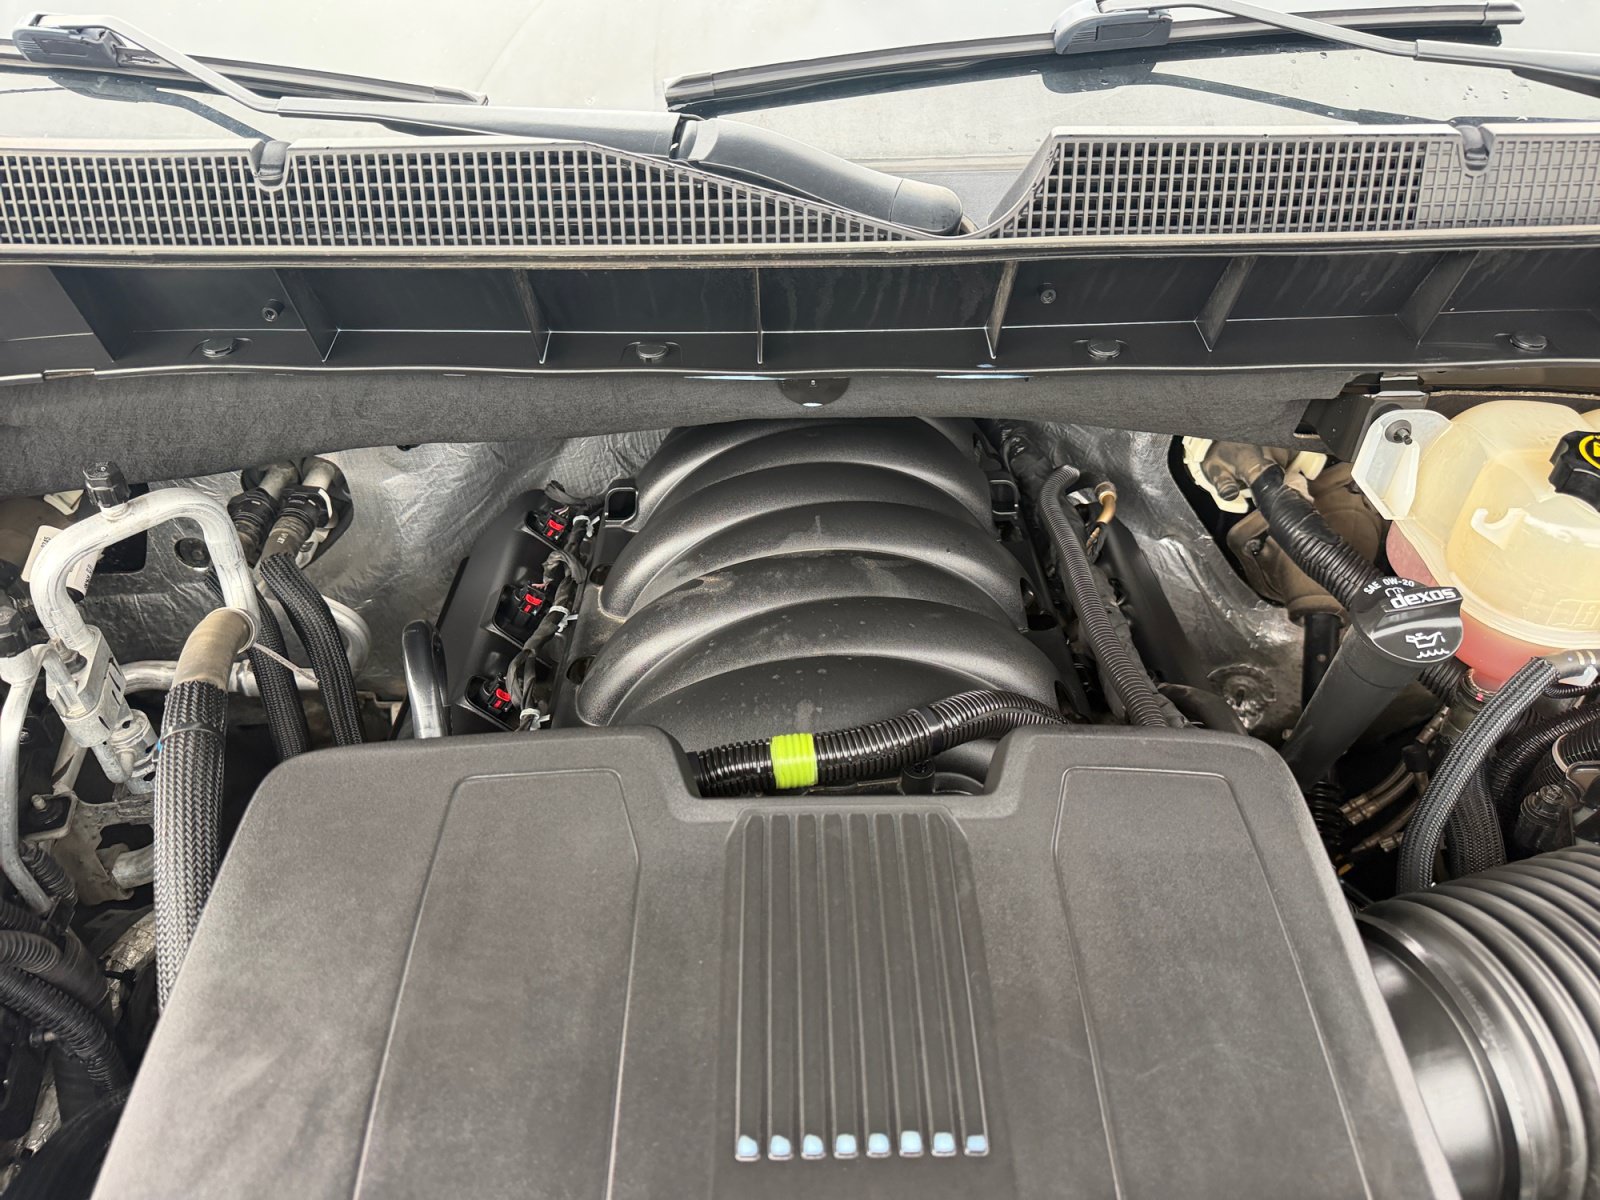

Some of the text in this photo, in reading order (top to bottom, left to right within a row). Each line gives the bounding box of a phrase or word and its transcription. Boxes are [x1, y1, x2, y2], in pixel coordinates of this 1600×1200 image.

[1363, 577, 1415, 595] SAE 0W-20
[1389, 588, 1457, 609] dexos
